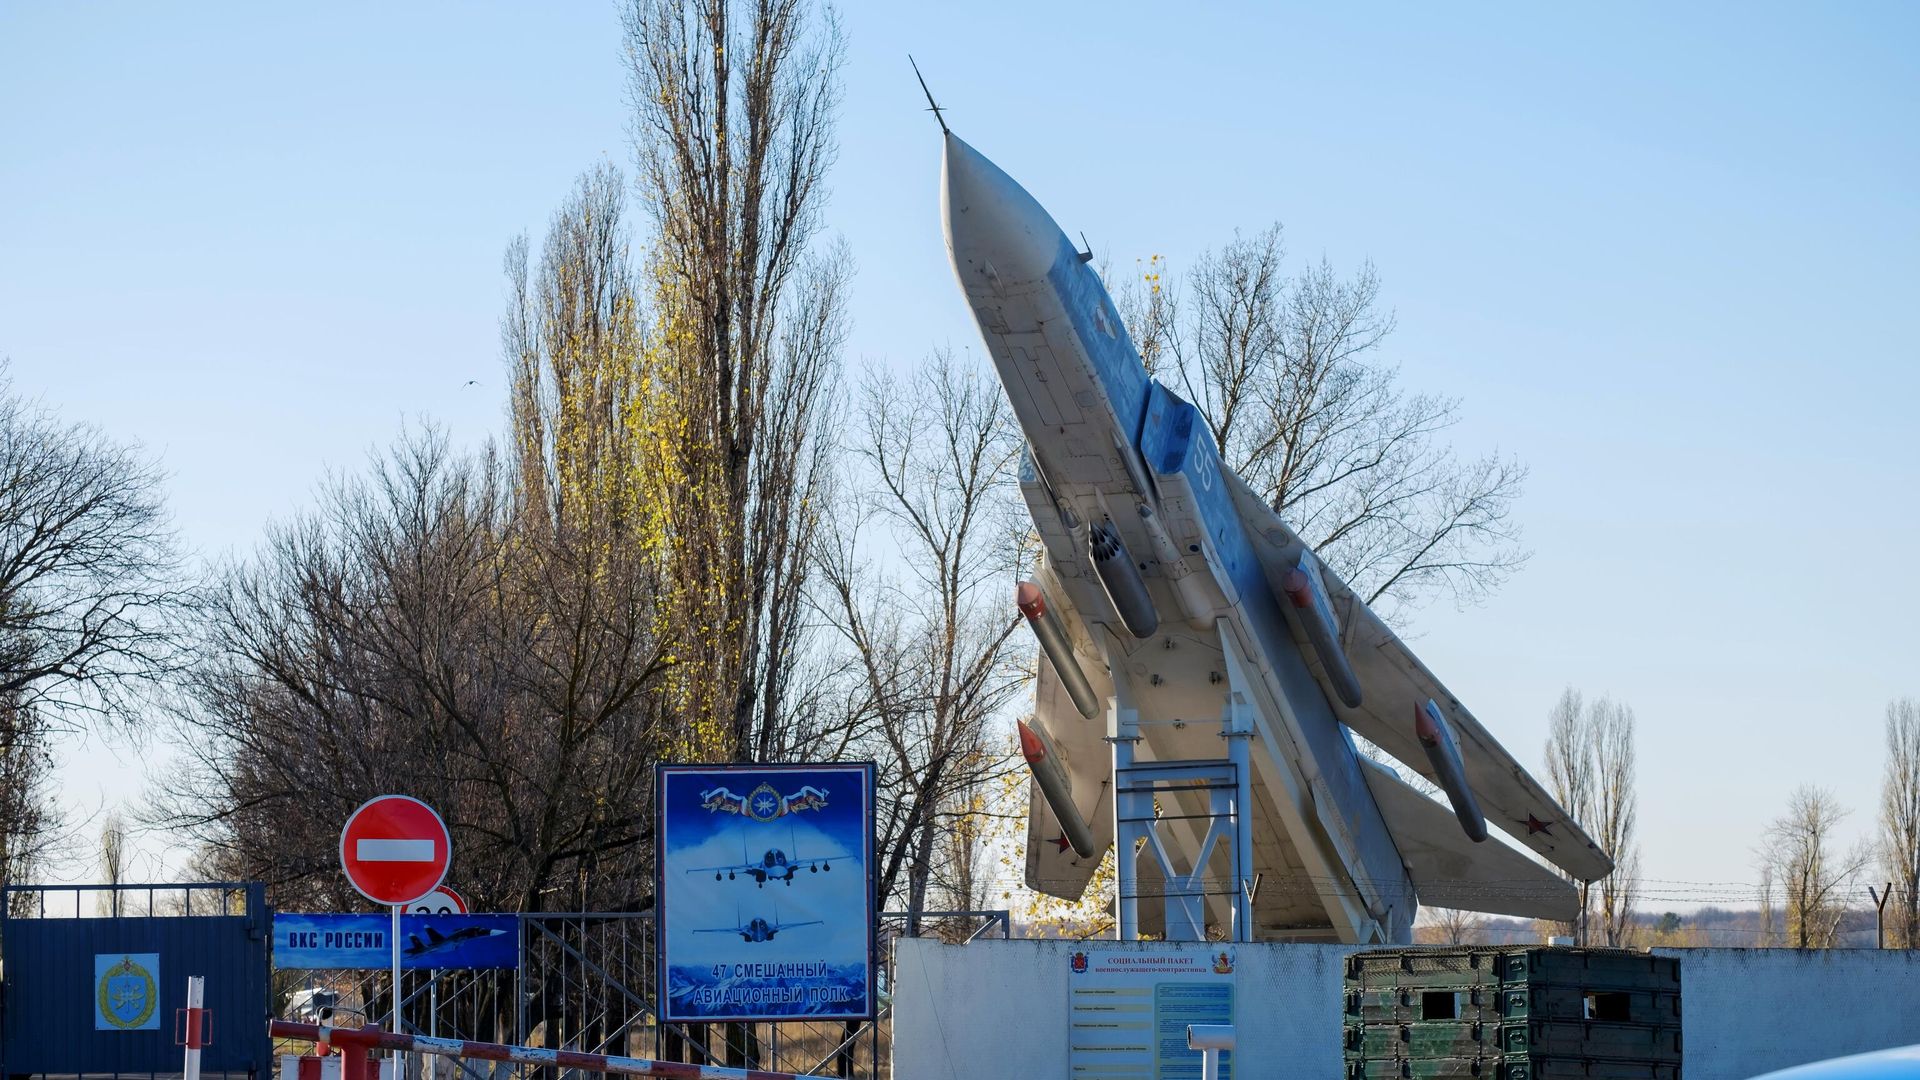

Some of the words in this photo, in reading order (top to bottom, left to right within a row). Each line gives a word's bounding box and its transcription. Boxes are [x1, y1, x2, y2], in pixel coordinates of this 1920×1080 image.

[1194, 432, 1214, 492] 55
[289, 931, 318, 949] ВКС
[325, 931, 384, 949] РОССИИ
[712, 964, 727, 978] 47
[734, 960, 828, 979] СМЕШАННЫЙ
[1107, 957, 1165, 965] СОЦИАЛЬНЫЙ
[694, 985, 804, 1006] АВИАЦИОННЫЙ
[809, 986, 848, 1002] ПОЛК
